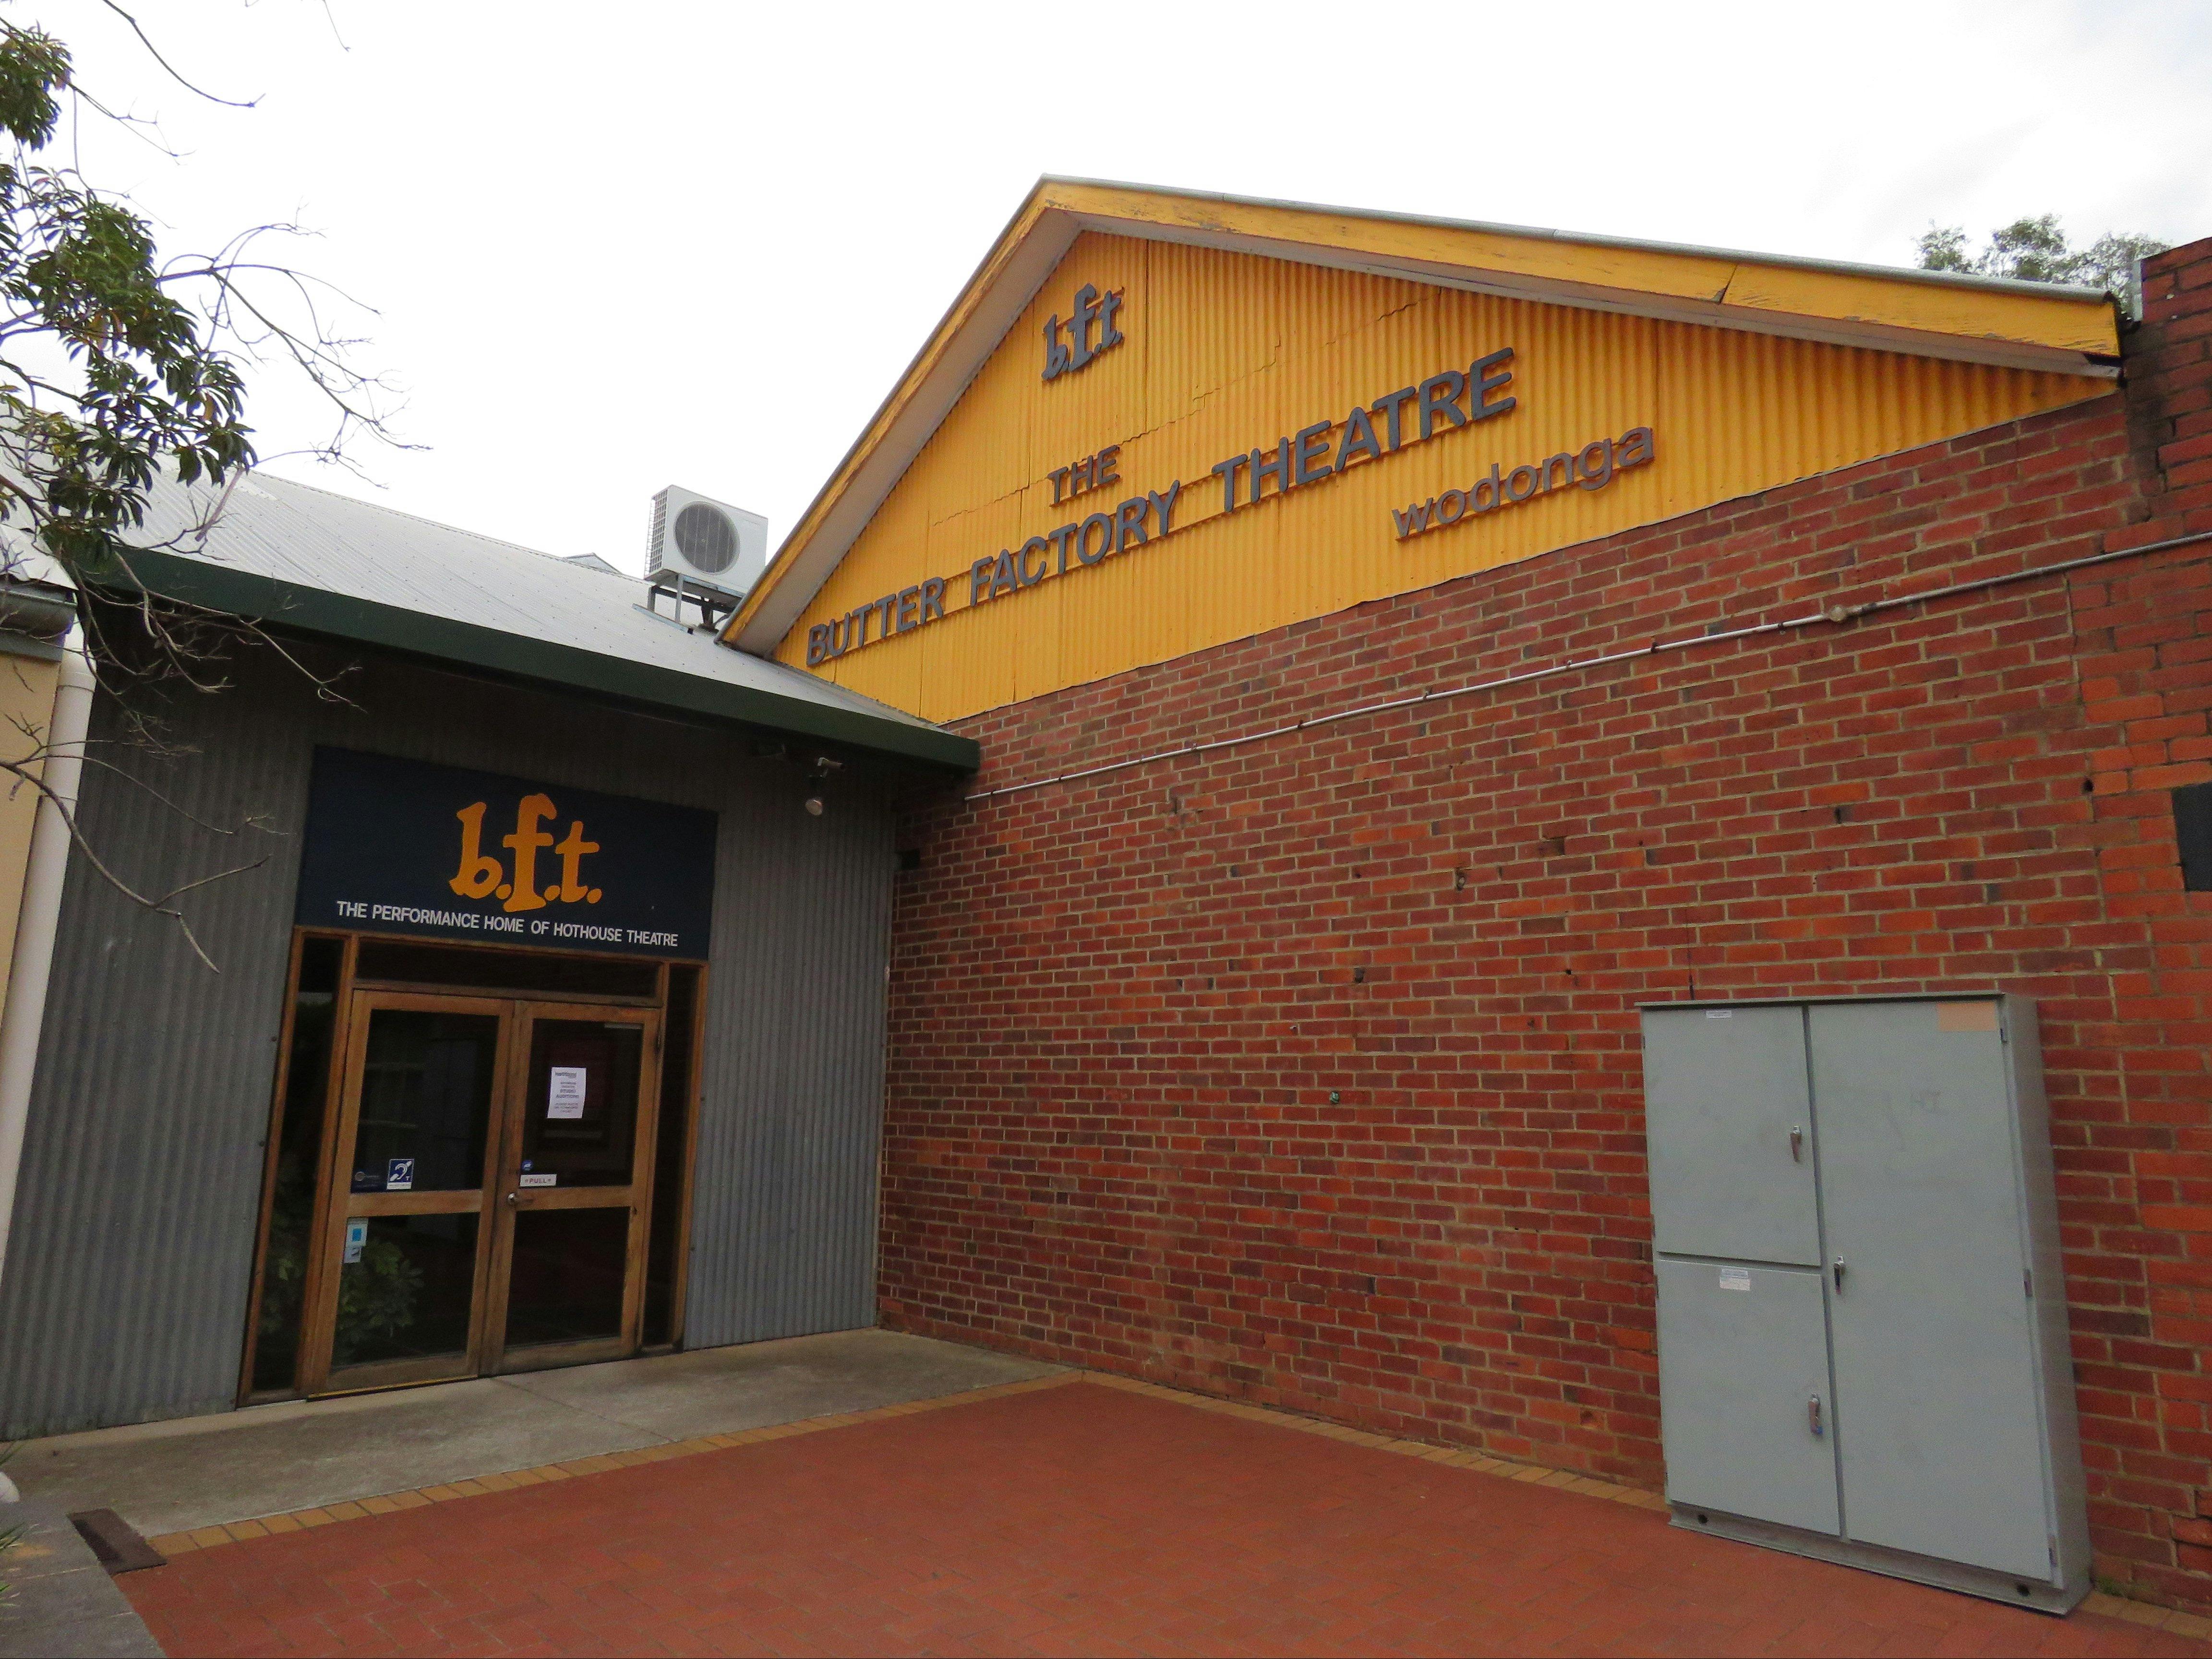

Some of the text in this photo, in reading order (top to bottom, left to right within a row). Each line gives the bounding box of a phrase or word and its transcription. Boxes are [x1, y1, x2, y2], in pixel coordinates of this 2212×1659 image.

[806, 347, 1516, 667] BUTTER FACTORY THEATRE
[1046, 445, 1120, 504] THE
[1392, 426, 1655, 539] wodonga
[448, 793, 602, 912] b.f.t.
[337, 900, 679, 947] THE PERFORMANCE HOME OF HOTHOUSE THEATRE
